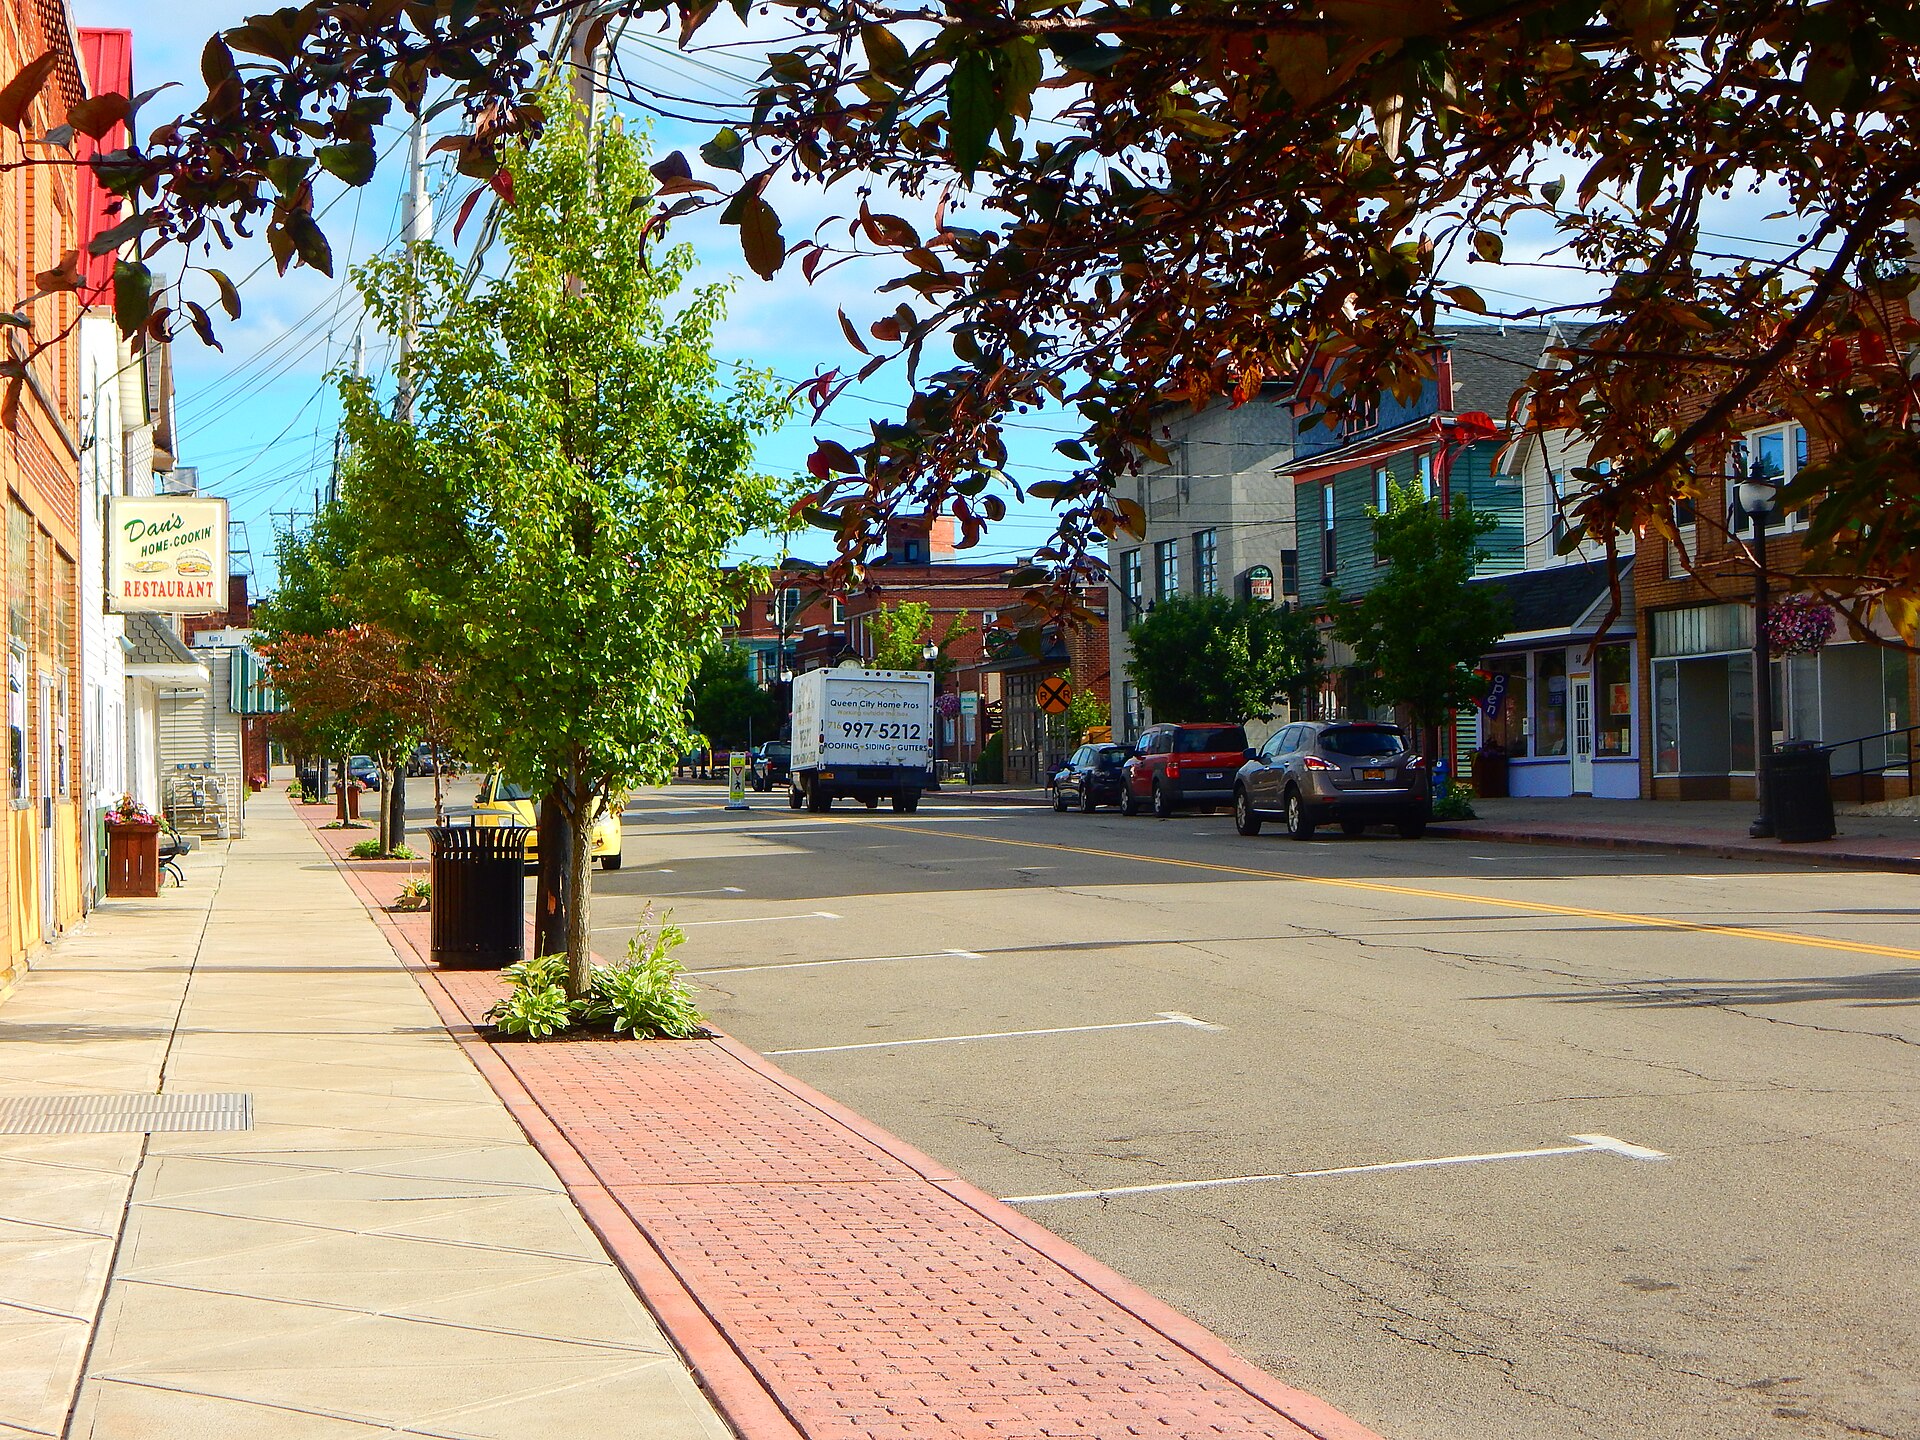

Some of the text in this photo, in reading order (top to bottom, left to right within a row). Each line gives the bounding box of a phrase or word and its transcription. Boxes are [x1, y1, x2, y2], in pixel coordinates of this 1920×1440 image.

[124, 513, 185, 543] Dan's
[124, 581, 213, 597] RESTAURANT
[1040, 690, 1071, 701] R R
[1486, 674, 1505, 715] open
[859, 700, 875, 708] City
[877, 701, 901, 709] Home
[903, 701, 919, 709] Pros
[827, 721, 842, 730] 716
